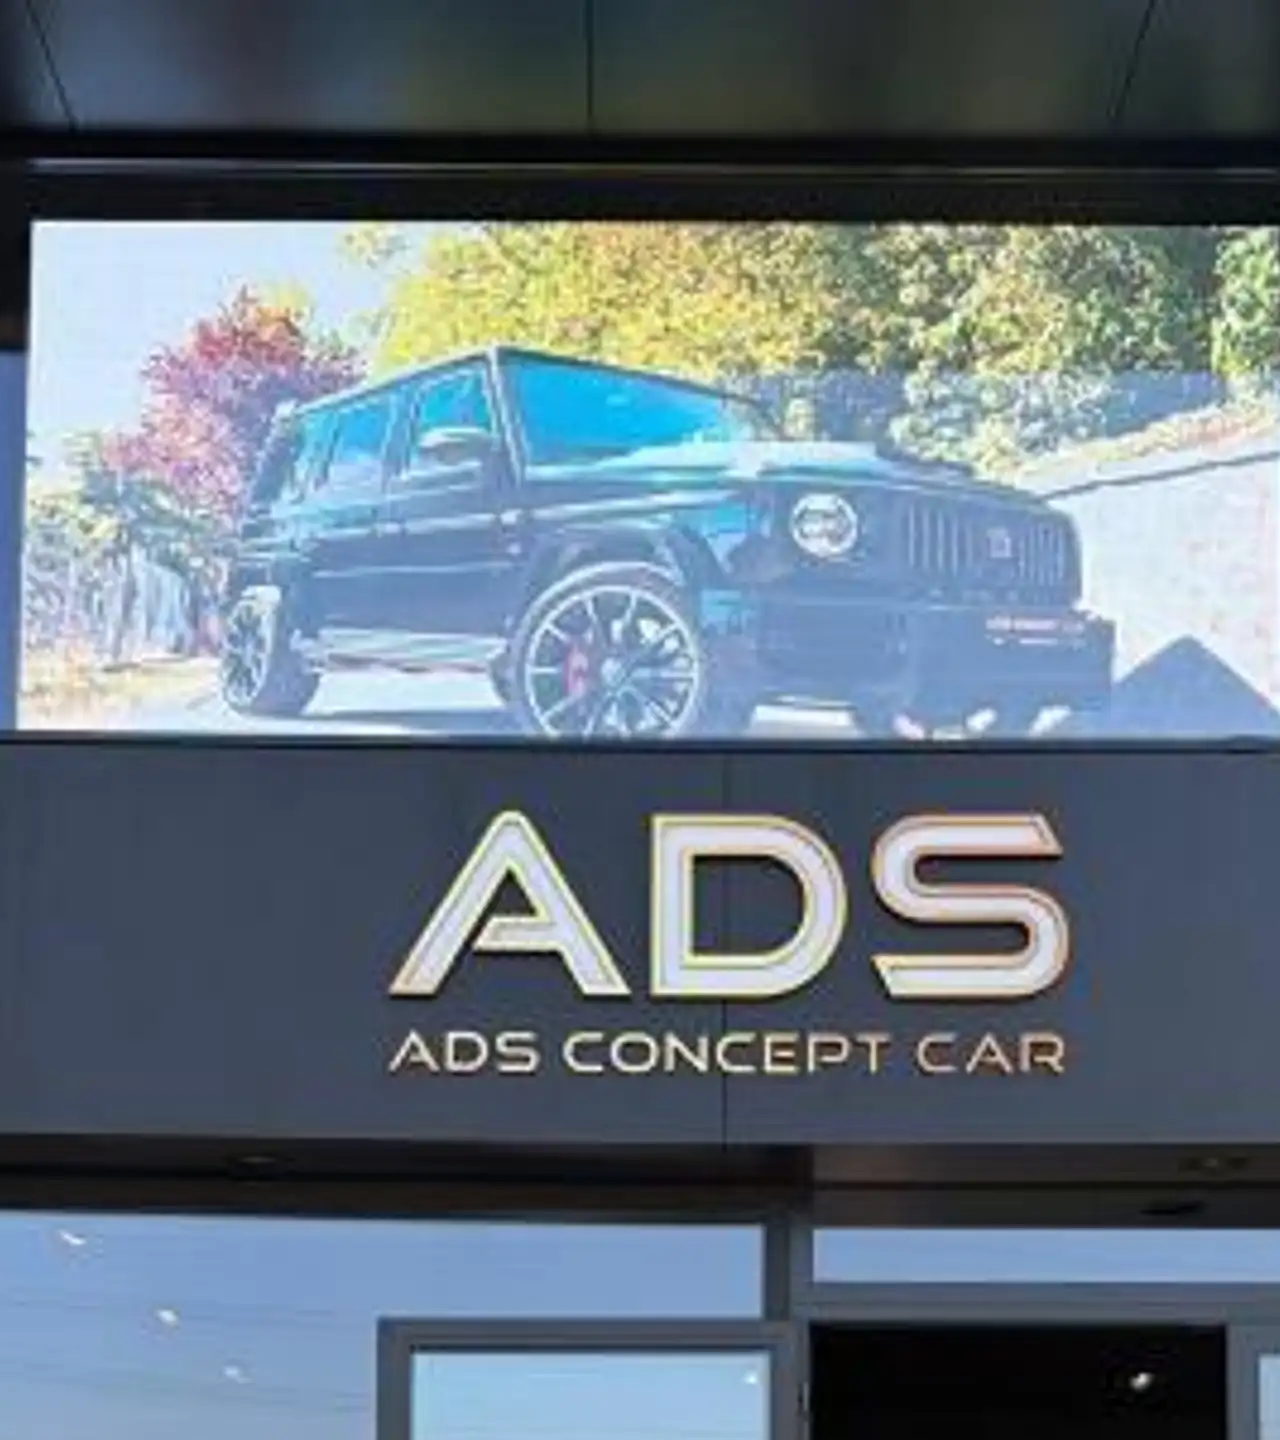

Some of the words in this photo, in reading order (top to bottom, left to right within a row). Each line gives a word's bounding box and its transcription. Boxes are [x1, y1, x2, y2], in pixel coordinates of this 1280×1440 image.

[388, 810, 1068, 996] ADS
[389, 1030, 540, 1072] ADS
[564, 1032, 890, 1073] CONCEPT
[917, 1033, 1066, 1073] CAR
